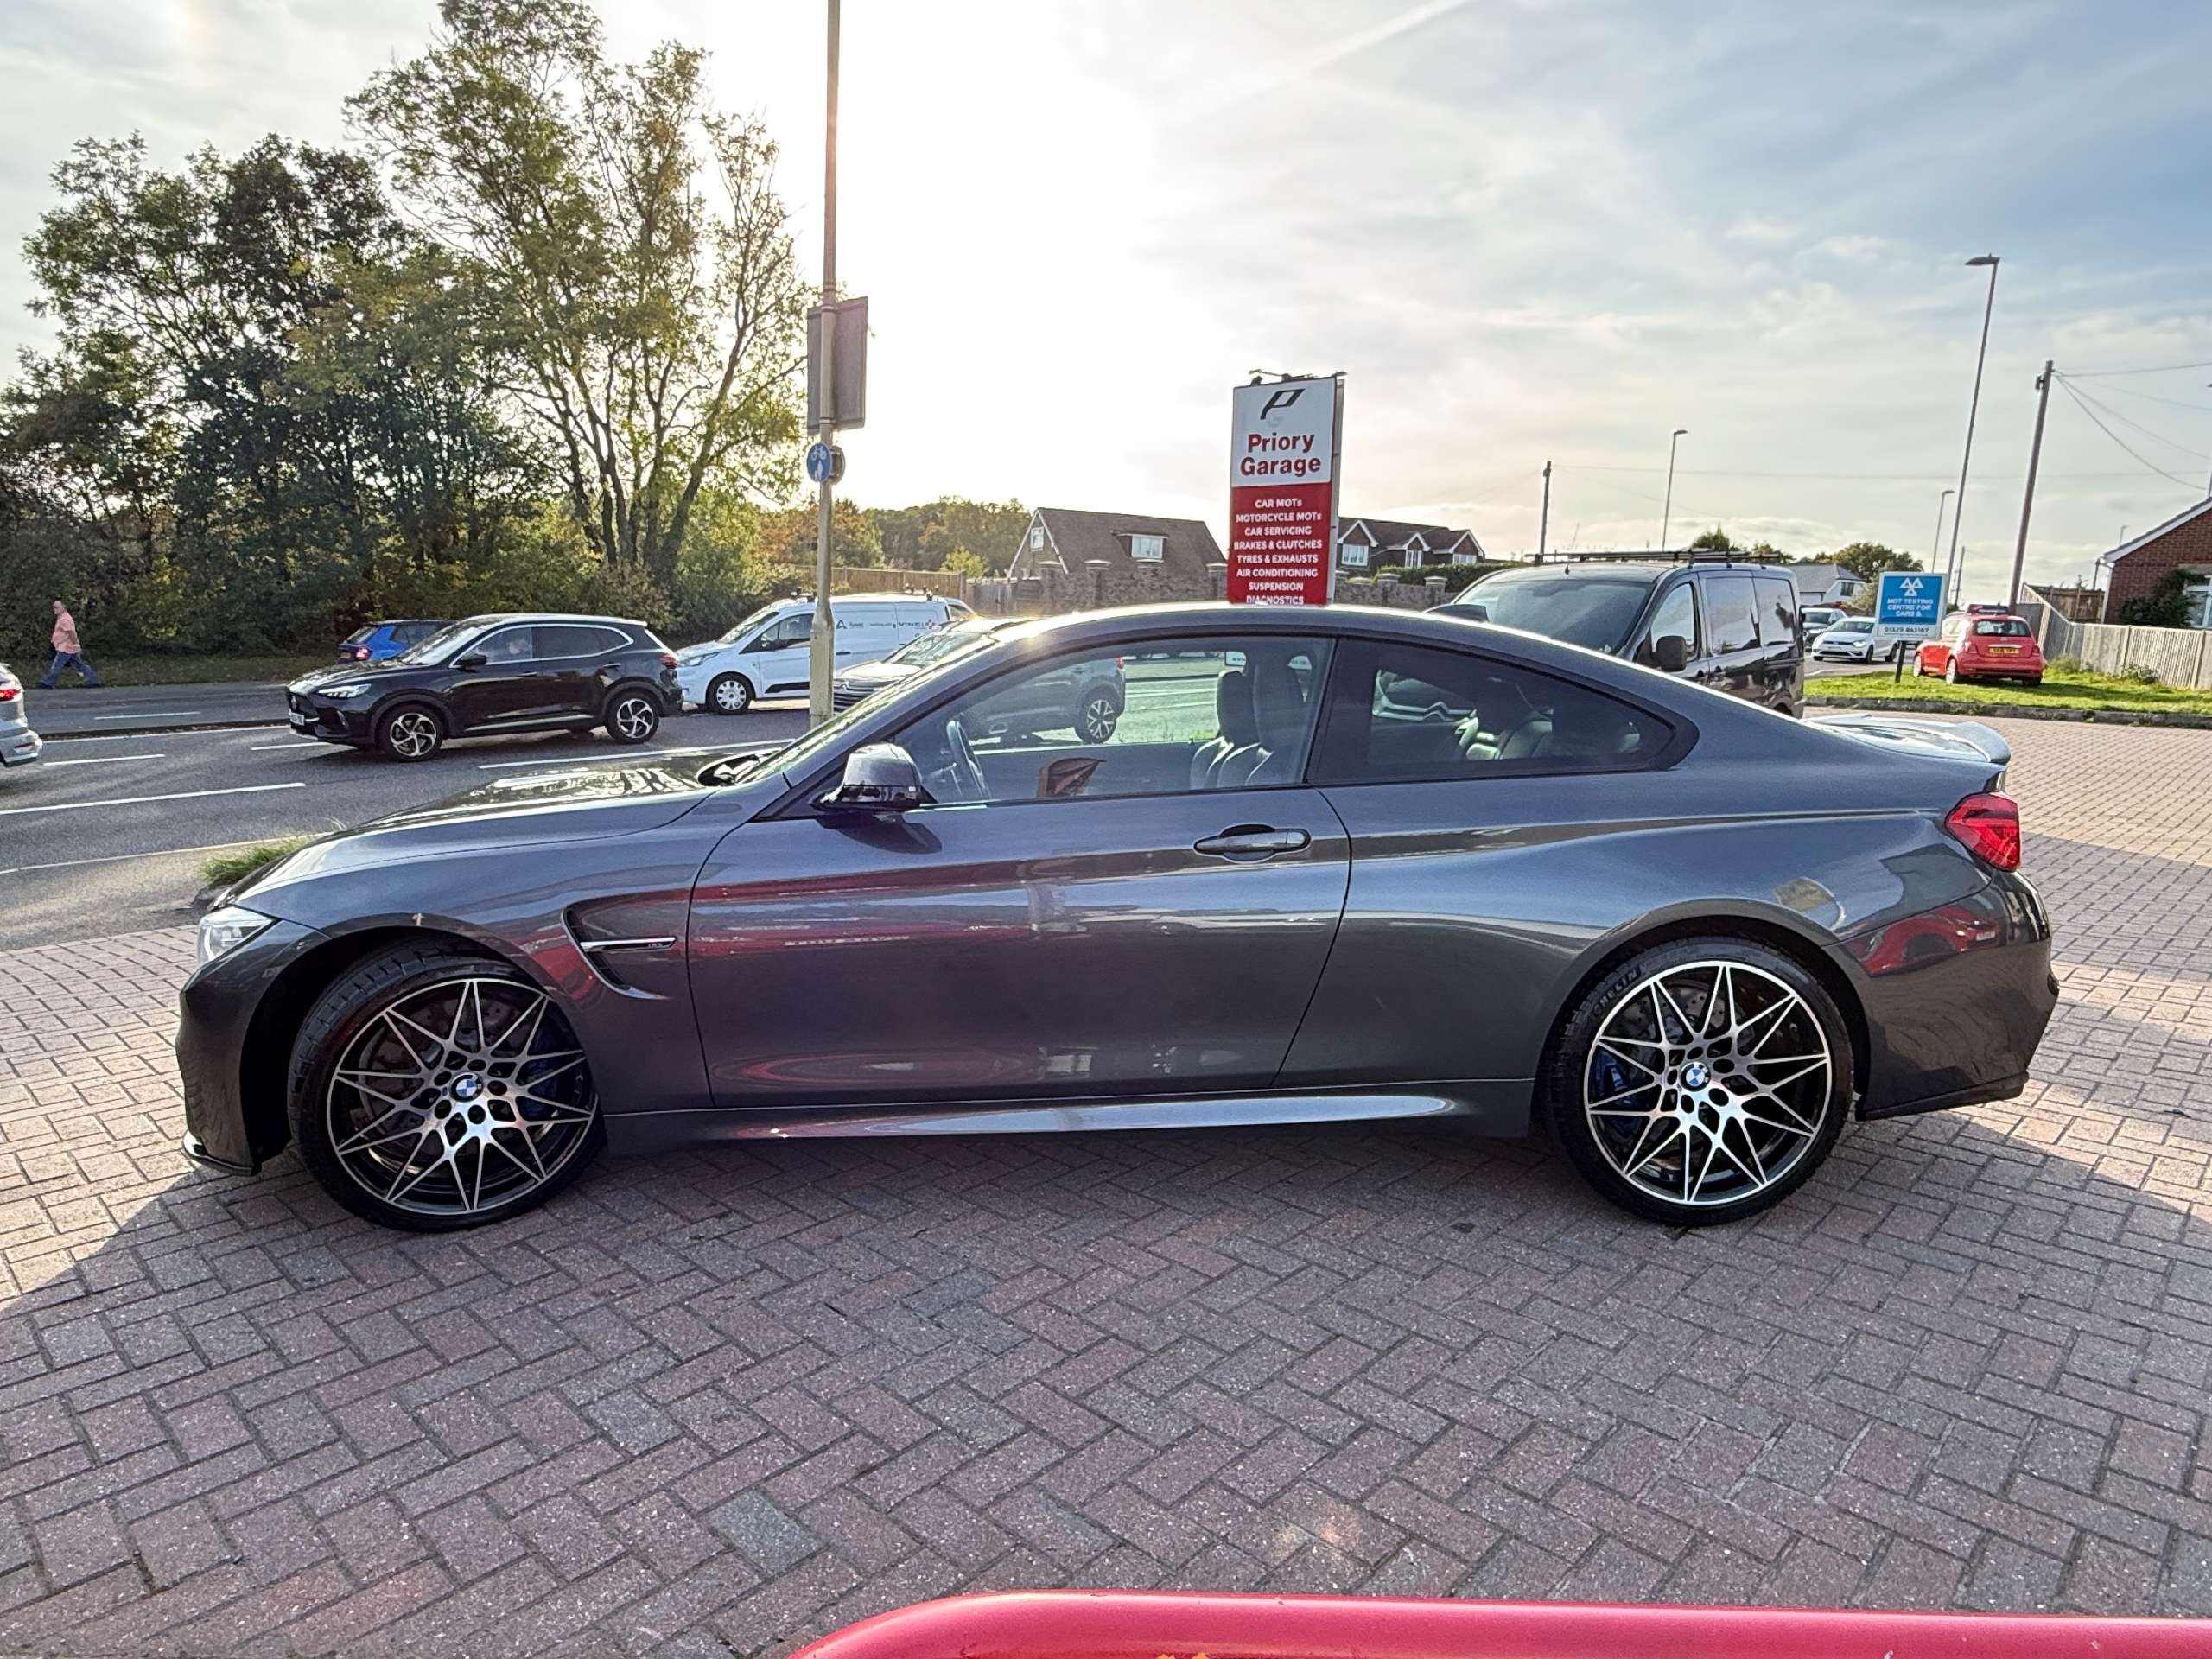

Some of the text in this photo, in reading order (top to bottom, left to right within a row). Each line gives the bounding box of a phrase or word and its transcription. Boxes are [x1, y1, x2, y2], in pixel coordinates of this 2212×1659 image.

[1247, 432, 1315, 454] Priory
[1240, 455, 1321, 477] Garage
[1255, 498, 1302, 508] CAR MOTs
[1236, 512, 1322, 523] MOTORCYCLE MOTs
[1244, 526, 1312, 536] CAR SERVICING
[1234, 539, 1323, 550] BRAKES & CLUTCHES
[1236, 554, 1319, 563] TYRES & EXHAUSTS
[1236, 568, 1318, 577] AIR CONDITIONING
[1249, 582, 1304, 591] SUSPENSION
